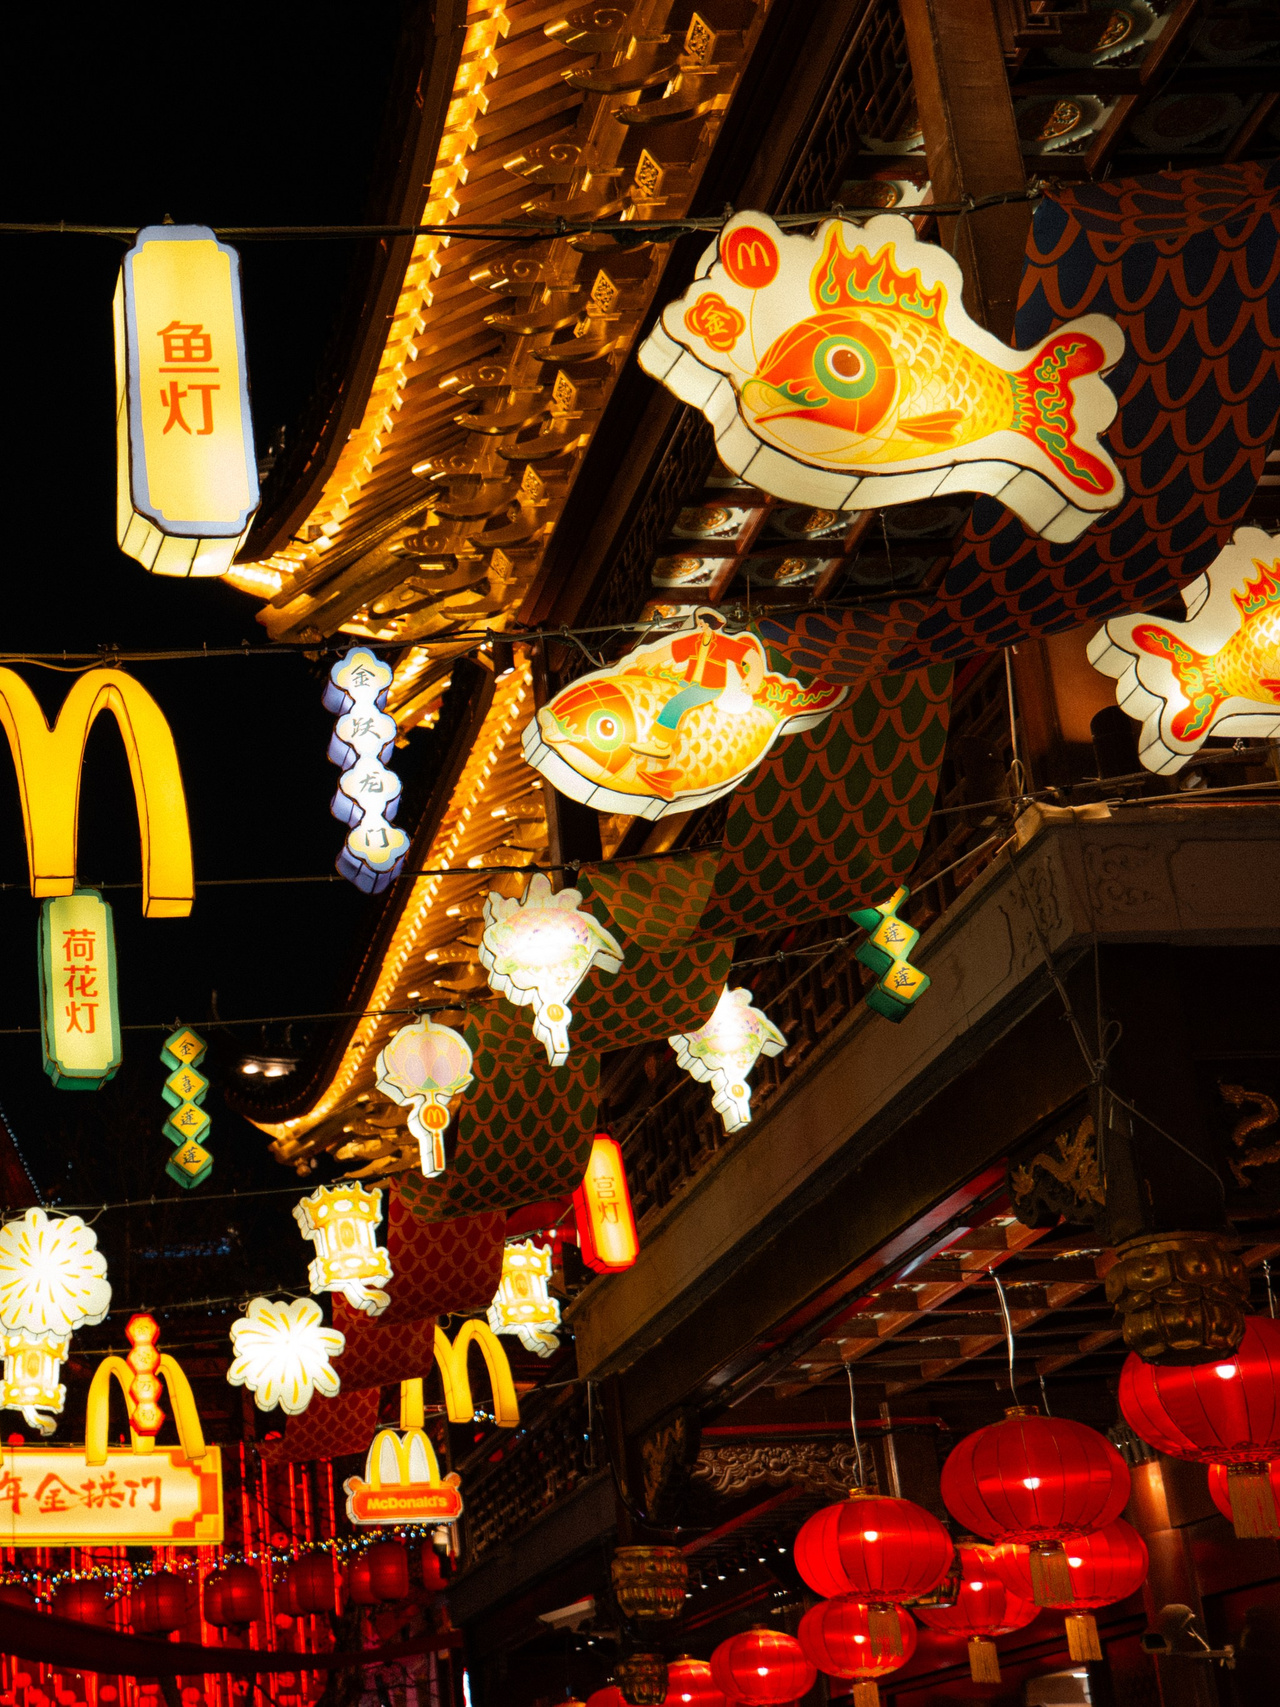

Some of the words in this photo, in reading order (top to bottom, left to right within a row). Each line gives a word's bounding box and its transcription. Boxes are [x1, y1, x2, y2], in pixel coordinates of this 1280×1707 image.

[701, 304, 731, 334] 金
[157, 320, 220, 436] 鱼灯
[350, 663, 390, 848] 金跃龙门
[62, 928, 99, 1034] 荷花灯
[593, 1176, 620, 1224] 宫灯
[367, 1496, 448, 1510] McDonald's
